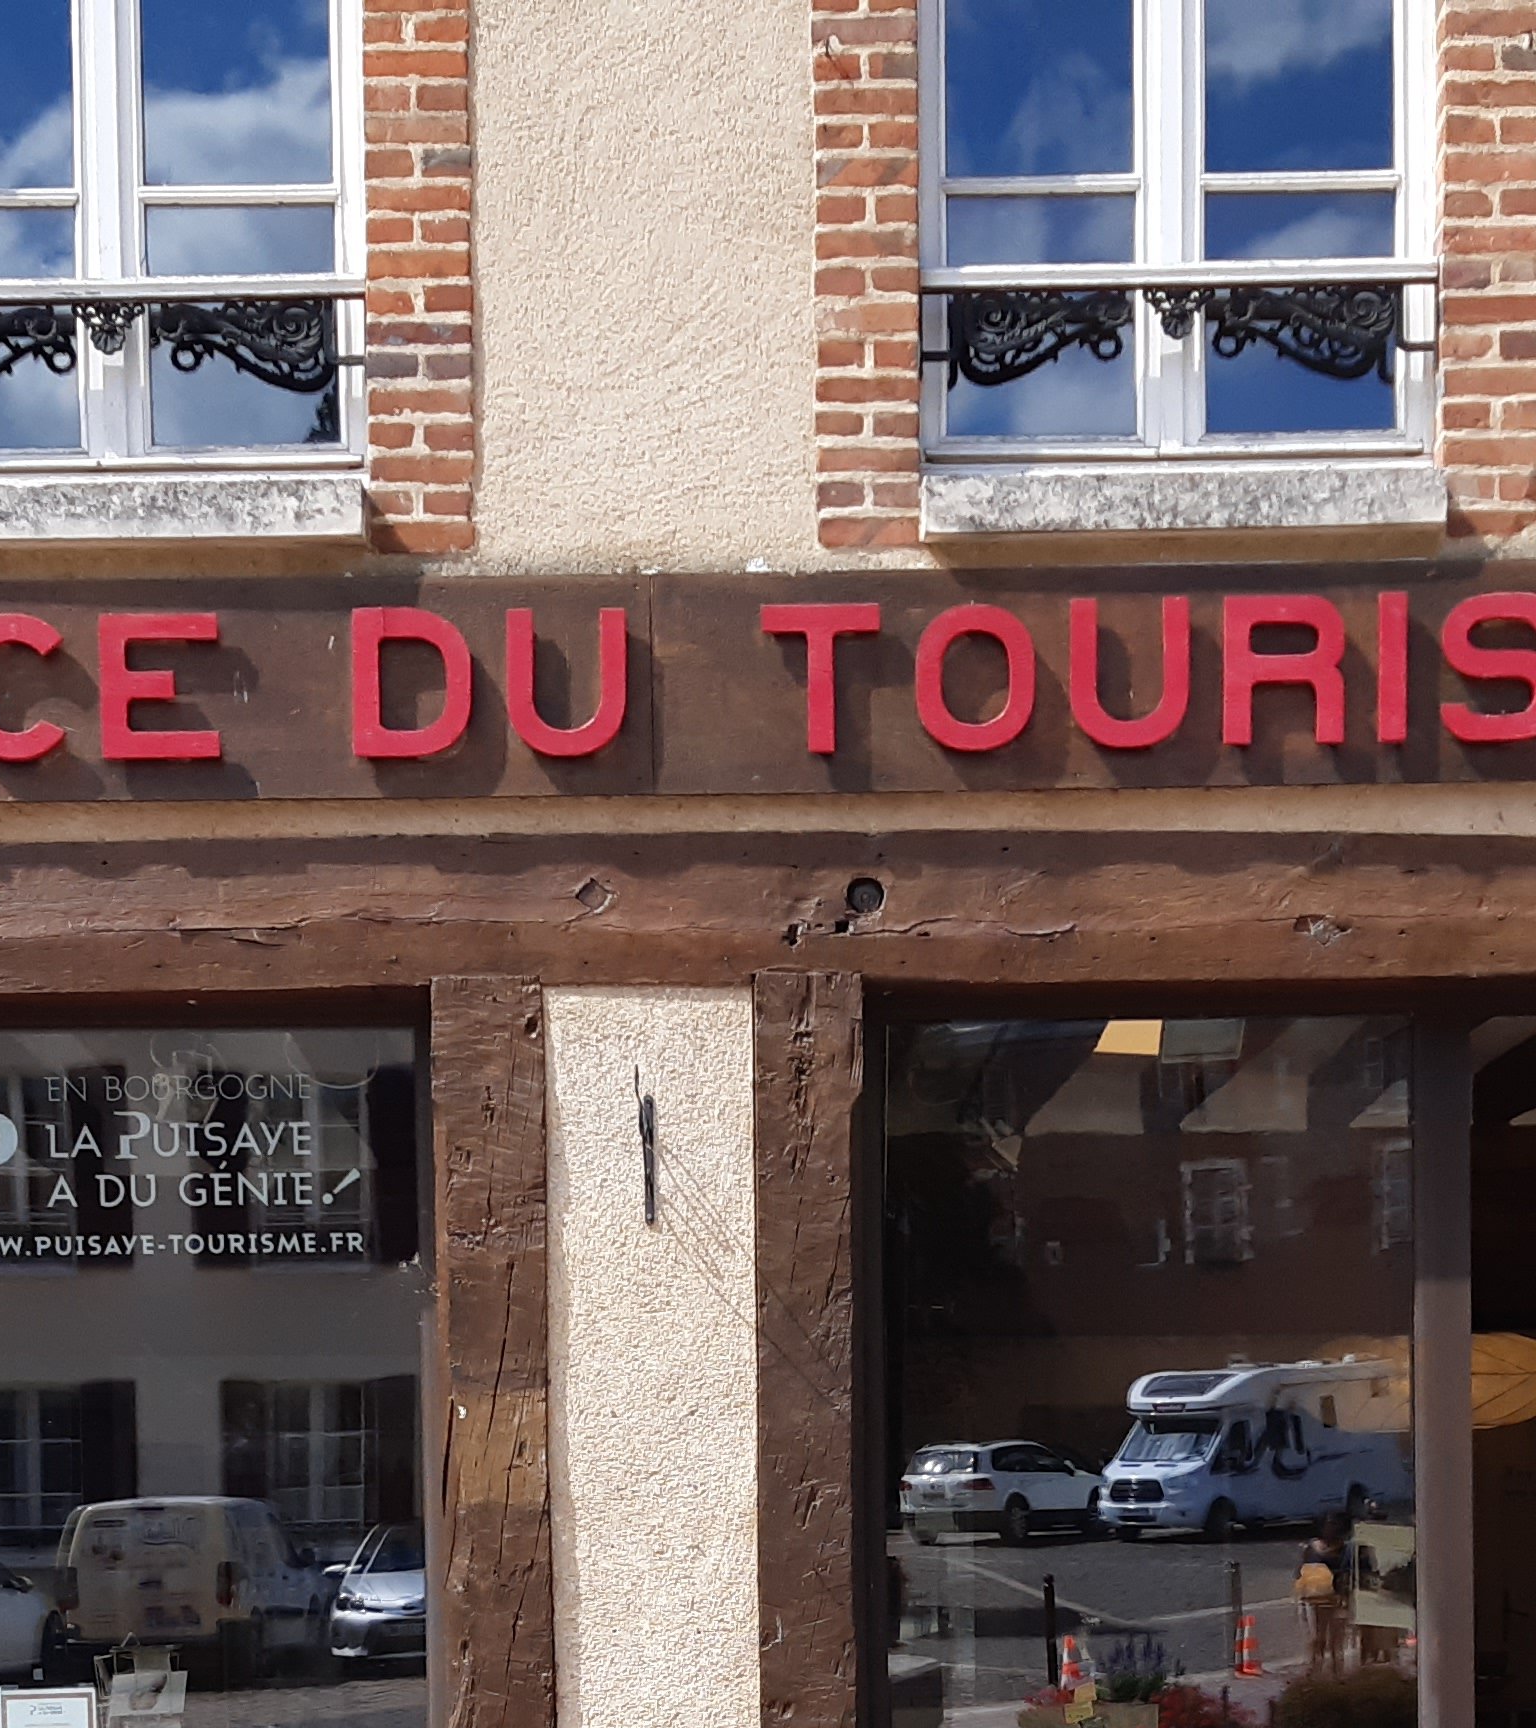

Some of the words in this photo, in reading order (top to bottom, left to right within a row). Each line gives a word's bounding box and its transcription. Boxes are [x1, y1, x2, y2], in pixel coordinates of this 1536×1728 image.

[351, 605, 628, 760] DU
[44, 1075, 88, 1102] EN
[103, 1073, 311, 1102] BOURGOGNE
[46, 1124, 103, 1159] LA
[47, 1174, 78, 1208] A
[95, 1173, 157, 1207] DU
